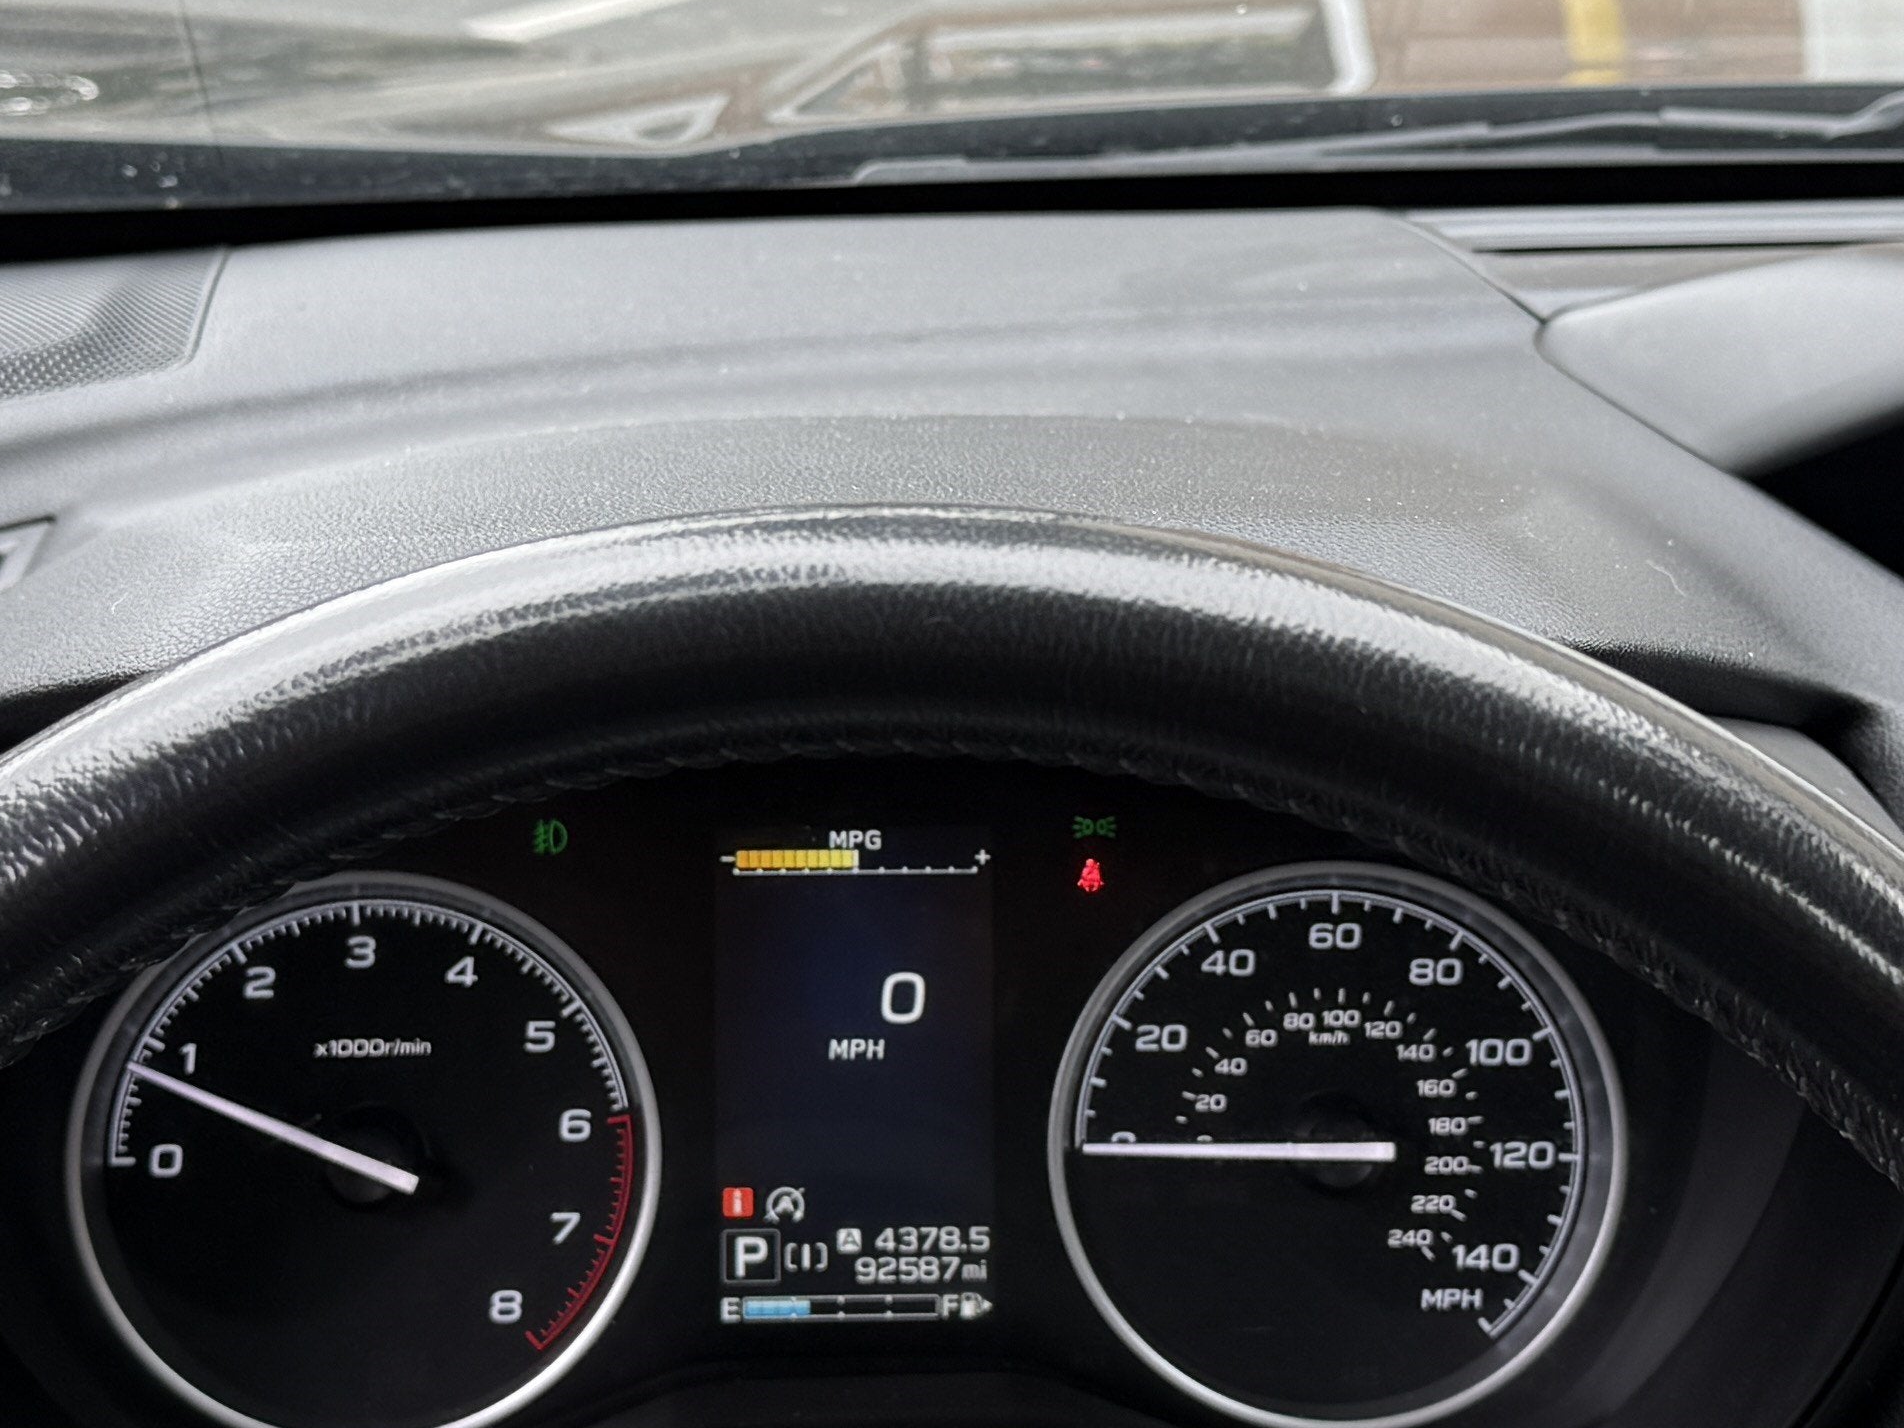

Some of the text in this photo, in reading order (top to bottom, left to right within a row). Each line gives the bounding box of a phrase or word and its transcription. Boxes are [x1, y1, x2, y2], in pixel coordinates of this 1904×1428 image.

[829, 829, 883, 851] MPG
[1308, 923, 1362, 951] 60
[346, 936, 376, 969] 3
[1201, 949, 1256, 977] 40
[244, 967, 276, 999] 2
[445, 957, 478, 988] 4
[1409, 958, 1463, 986] 80
[880, 971, 926, 1024] 0
[1283, 1012, 1315, 1030] 80
[1322, 1009, 1361, 1027] 100
[1364, 1020, 1403, 1039] 120
[313, 1038, 432, 1059] x1000r/min
[525, 1021, 556, 1052] 5
[828, 1038, 885, 1060] MPH
[1135, 1024, 1188, 1052] 20
[1245, 1029, 1278, 1047] 60
[1308, 1029, 1349, 1046] km/h
[180, 1044, 197, 1074] 1
[1397, 1043, 1436, 1062] 140
[1466, 1038, 1532, 1066] 100
[1214, 1057, 1248, 1076] 40
[1195, 1093, 1228, 1112] 20
[1416, 1079, 1456, 1098] 160
[560, 1110, 592, 1142] 6
[1428, 1116, 1467, 1135] 180
[149, 1144, 184, 1177] 0
[1424, 1156, 1469, 1174] 200
[1490, 1140, 1556, 1169] 120
[1410, 1195, 1454, 1214] 220
[550, 1212, 582, 1244] 7
[874, 1225, 991, 1253] 4378.5
[1388, 1229, 1431, 1248] 240
[734, 1235, 768, 1278] P
[855, 1256, 988, 1285] 92587 mi
[1452, 1243, 1520, 1272] 140
[489, 1290, 523, 1324] 8
[720, 1296, 742, 1322] E
[1421, 1288, 1483, 1311] MPH
